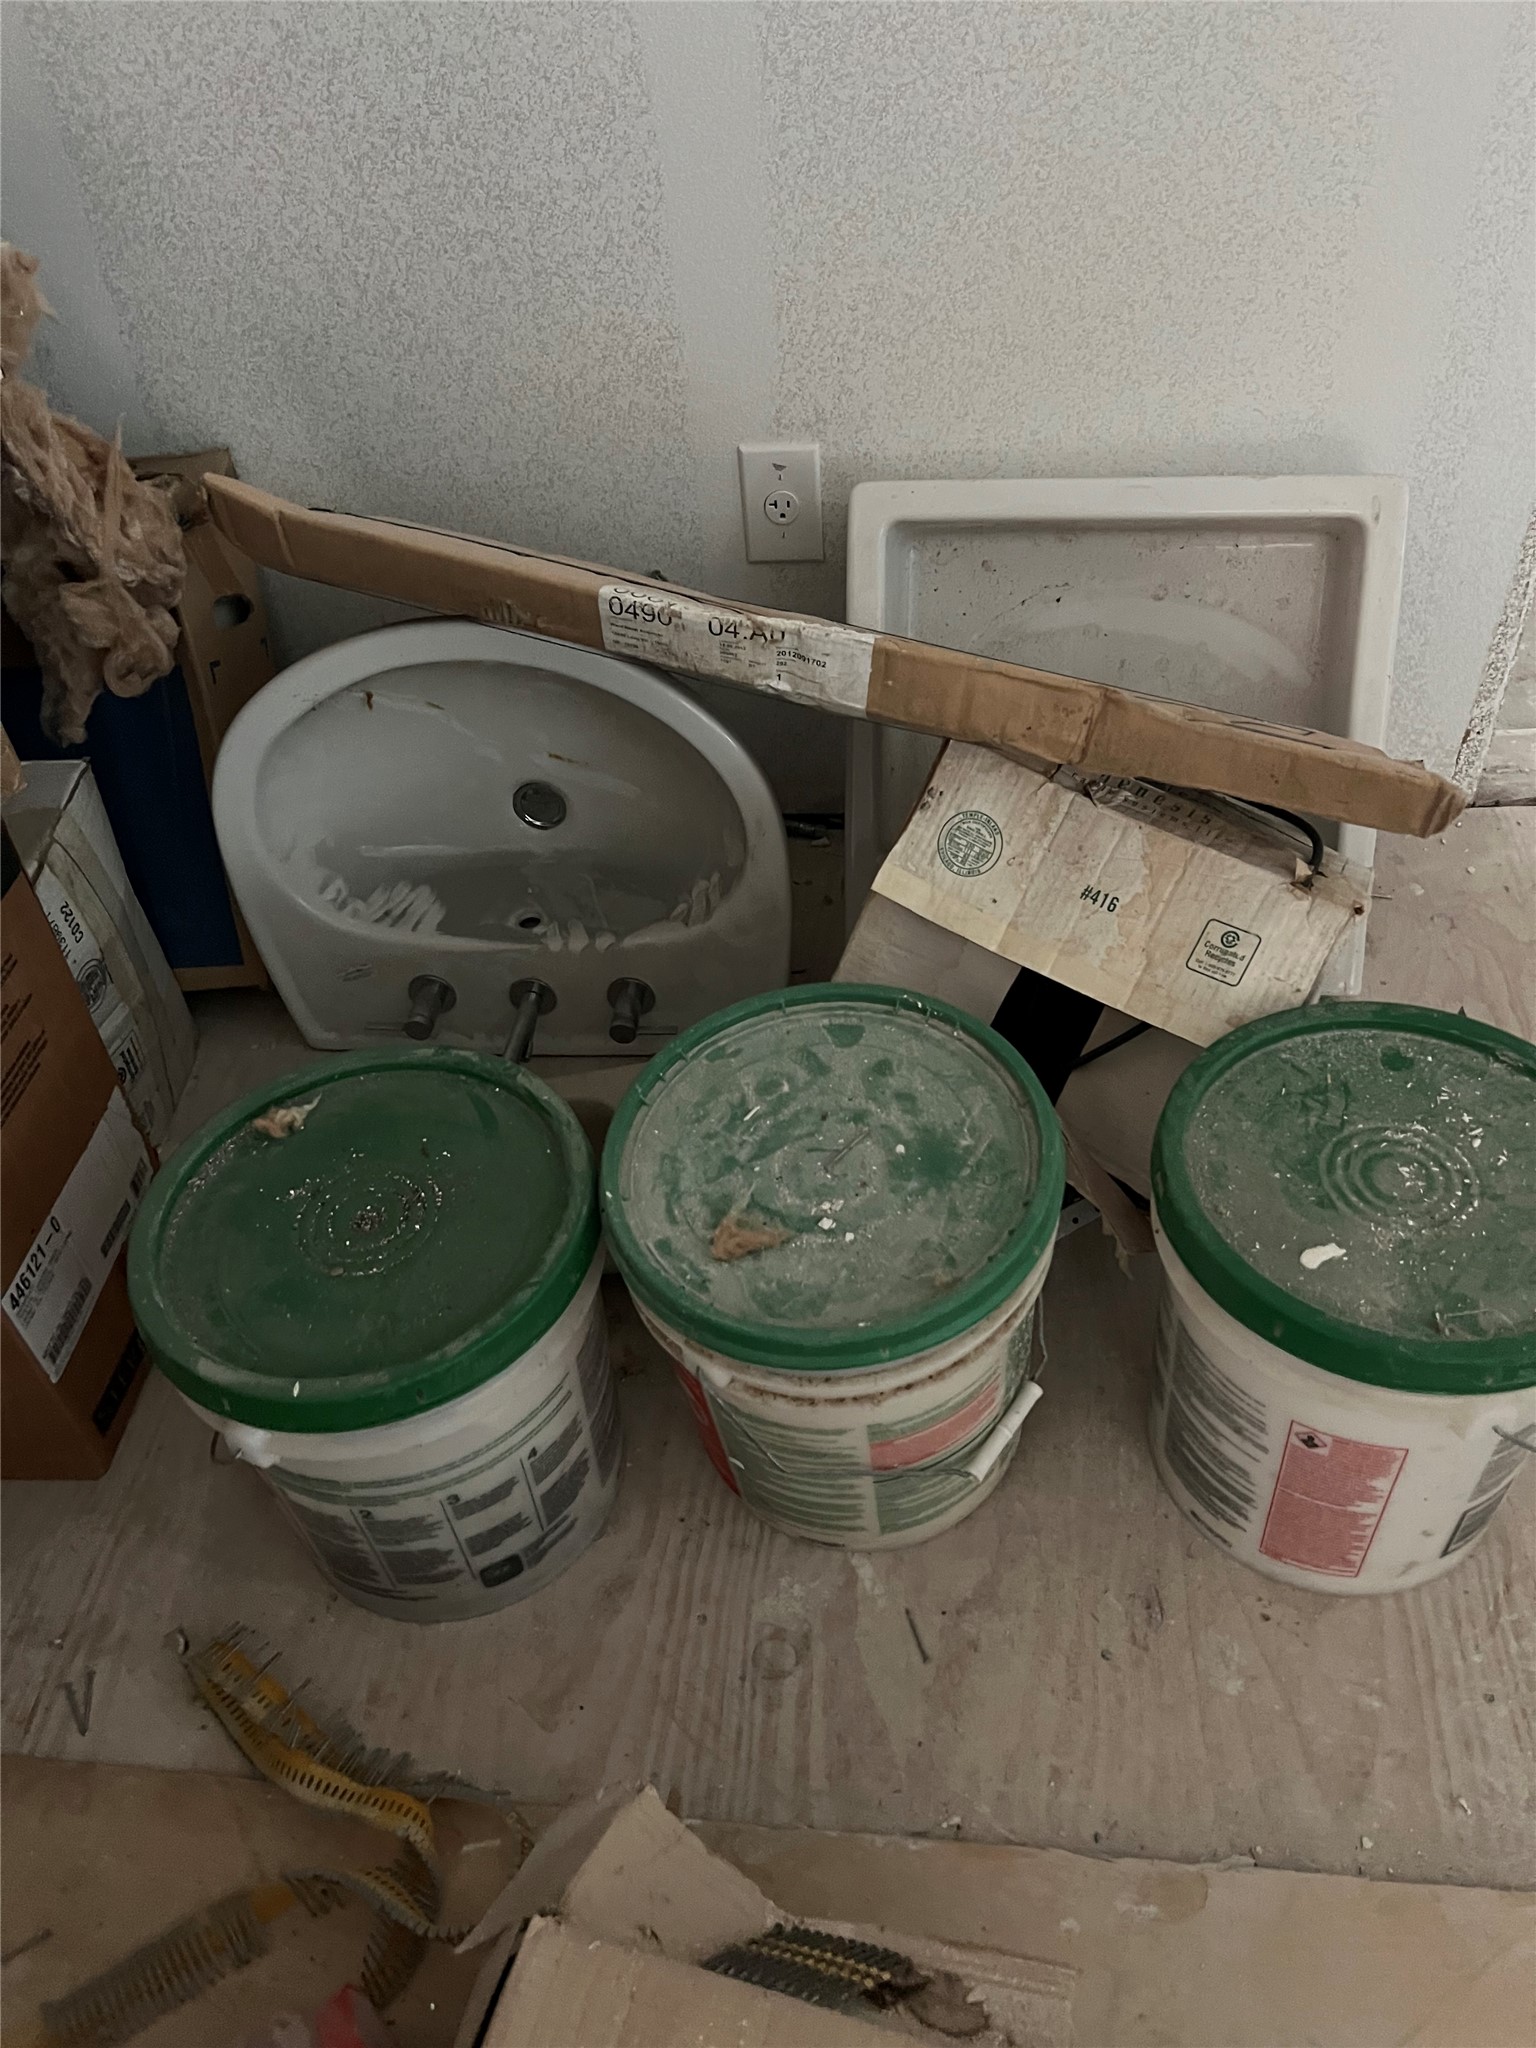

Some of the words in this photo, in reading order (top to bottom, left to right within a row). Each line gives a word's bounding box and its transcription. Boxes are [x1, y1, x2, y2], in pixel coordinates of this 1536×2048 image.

[776, 650, 827, 668] 2012091702
[1080, 885, 1119, 912] #416
[60, 901, 84, 944] C0122
